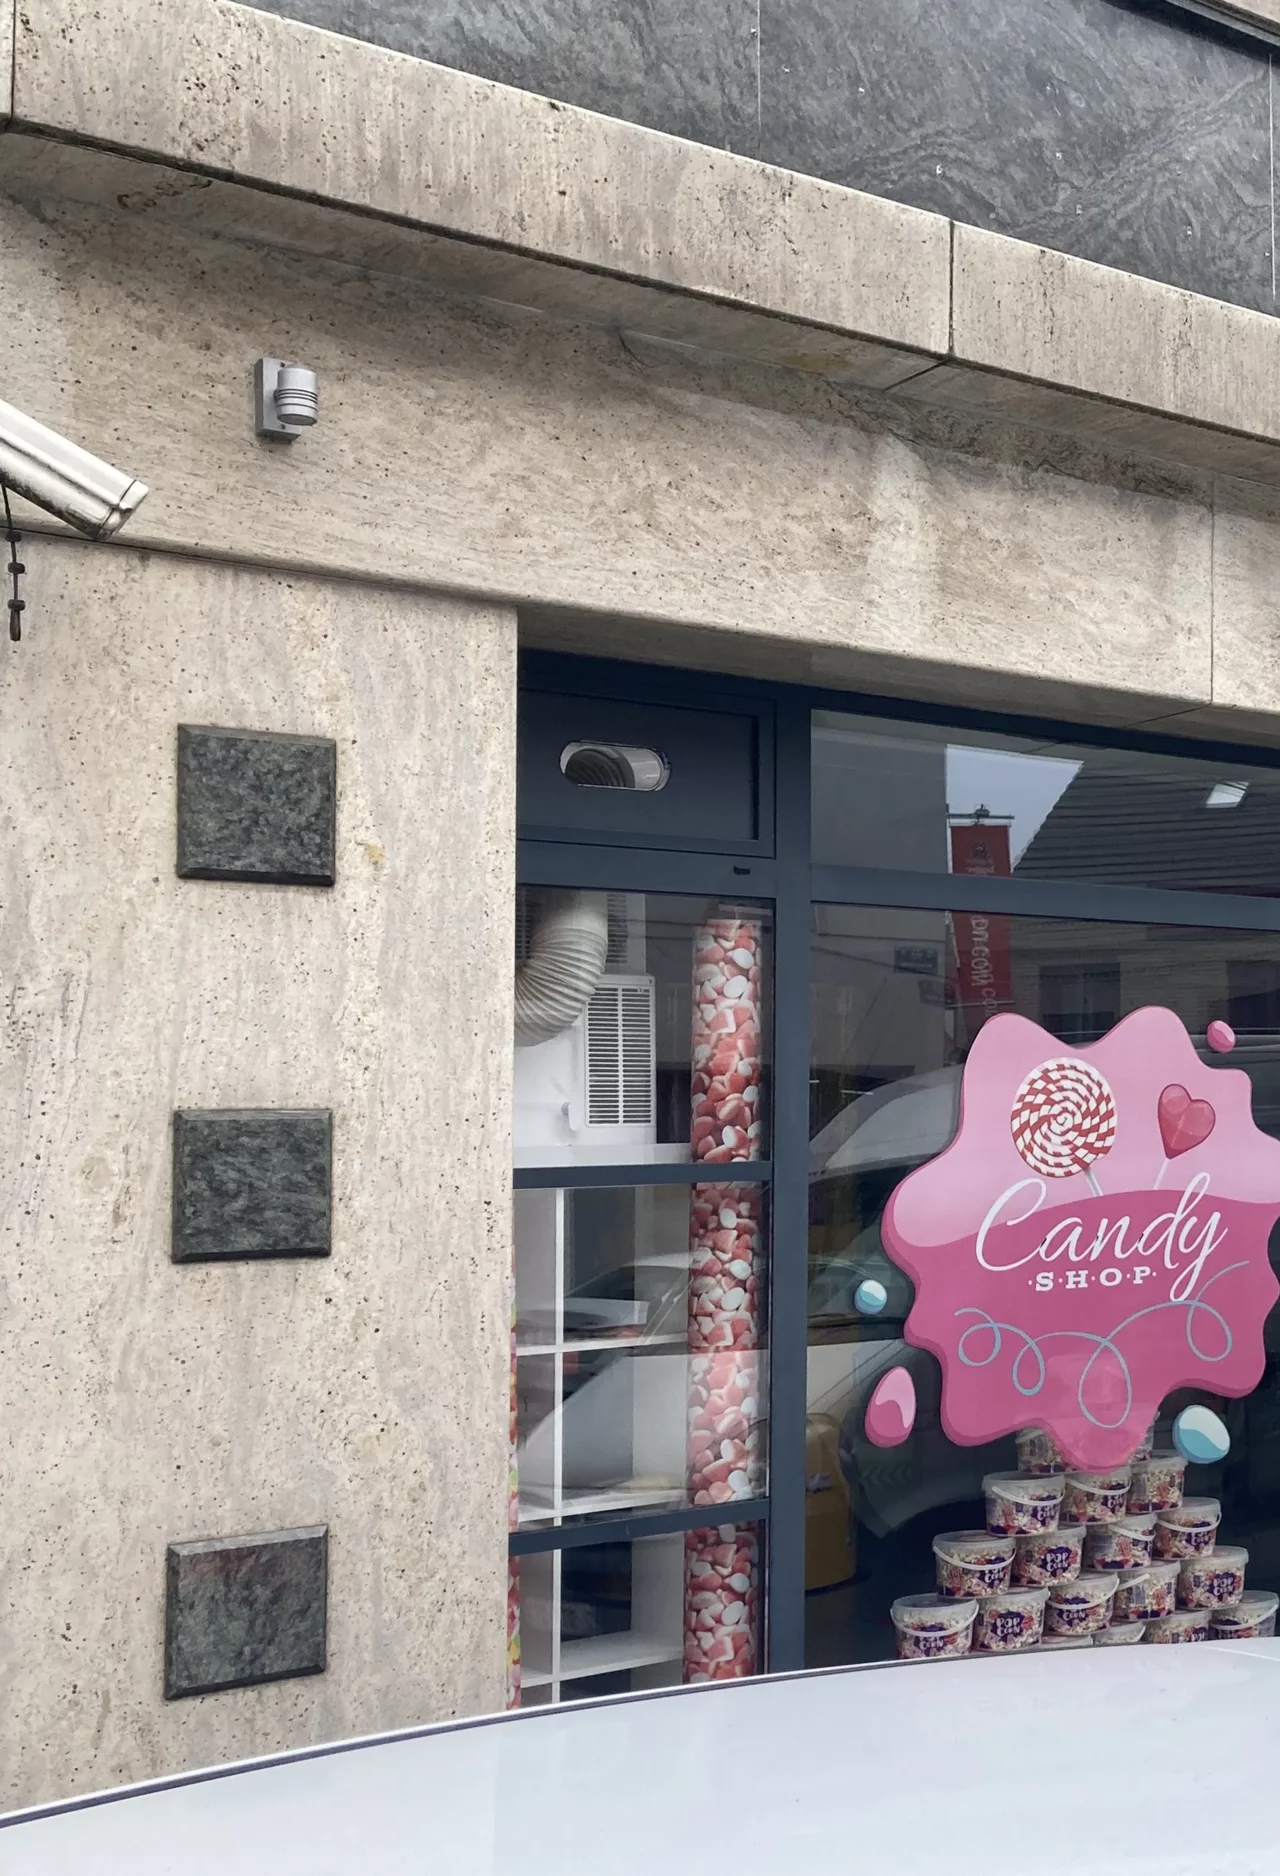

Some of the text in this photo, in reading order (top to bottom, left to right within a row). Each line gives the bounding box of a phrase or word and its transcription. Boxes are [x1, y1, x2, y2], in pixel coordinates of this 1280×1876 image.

[976, 1172, 1228, 1302] Candy
[1046, 1552, 1069, 1563] POP
[1213, 1577, 1234, 1587] POP
[996, 1617, 1020, 1628] POP
